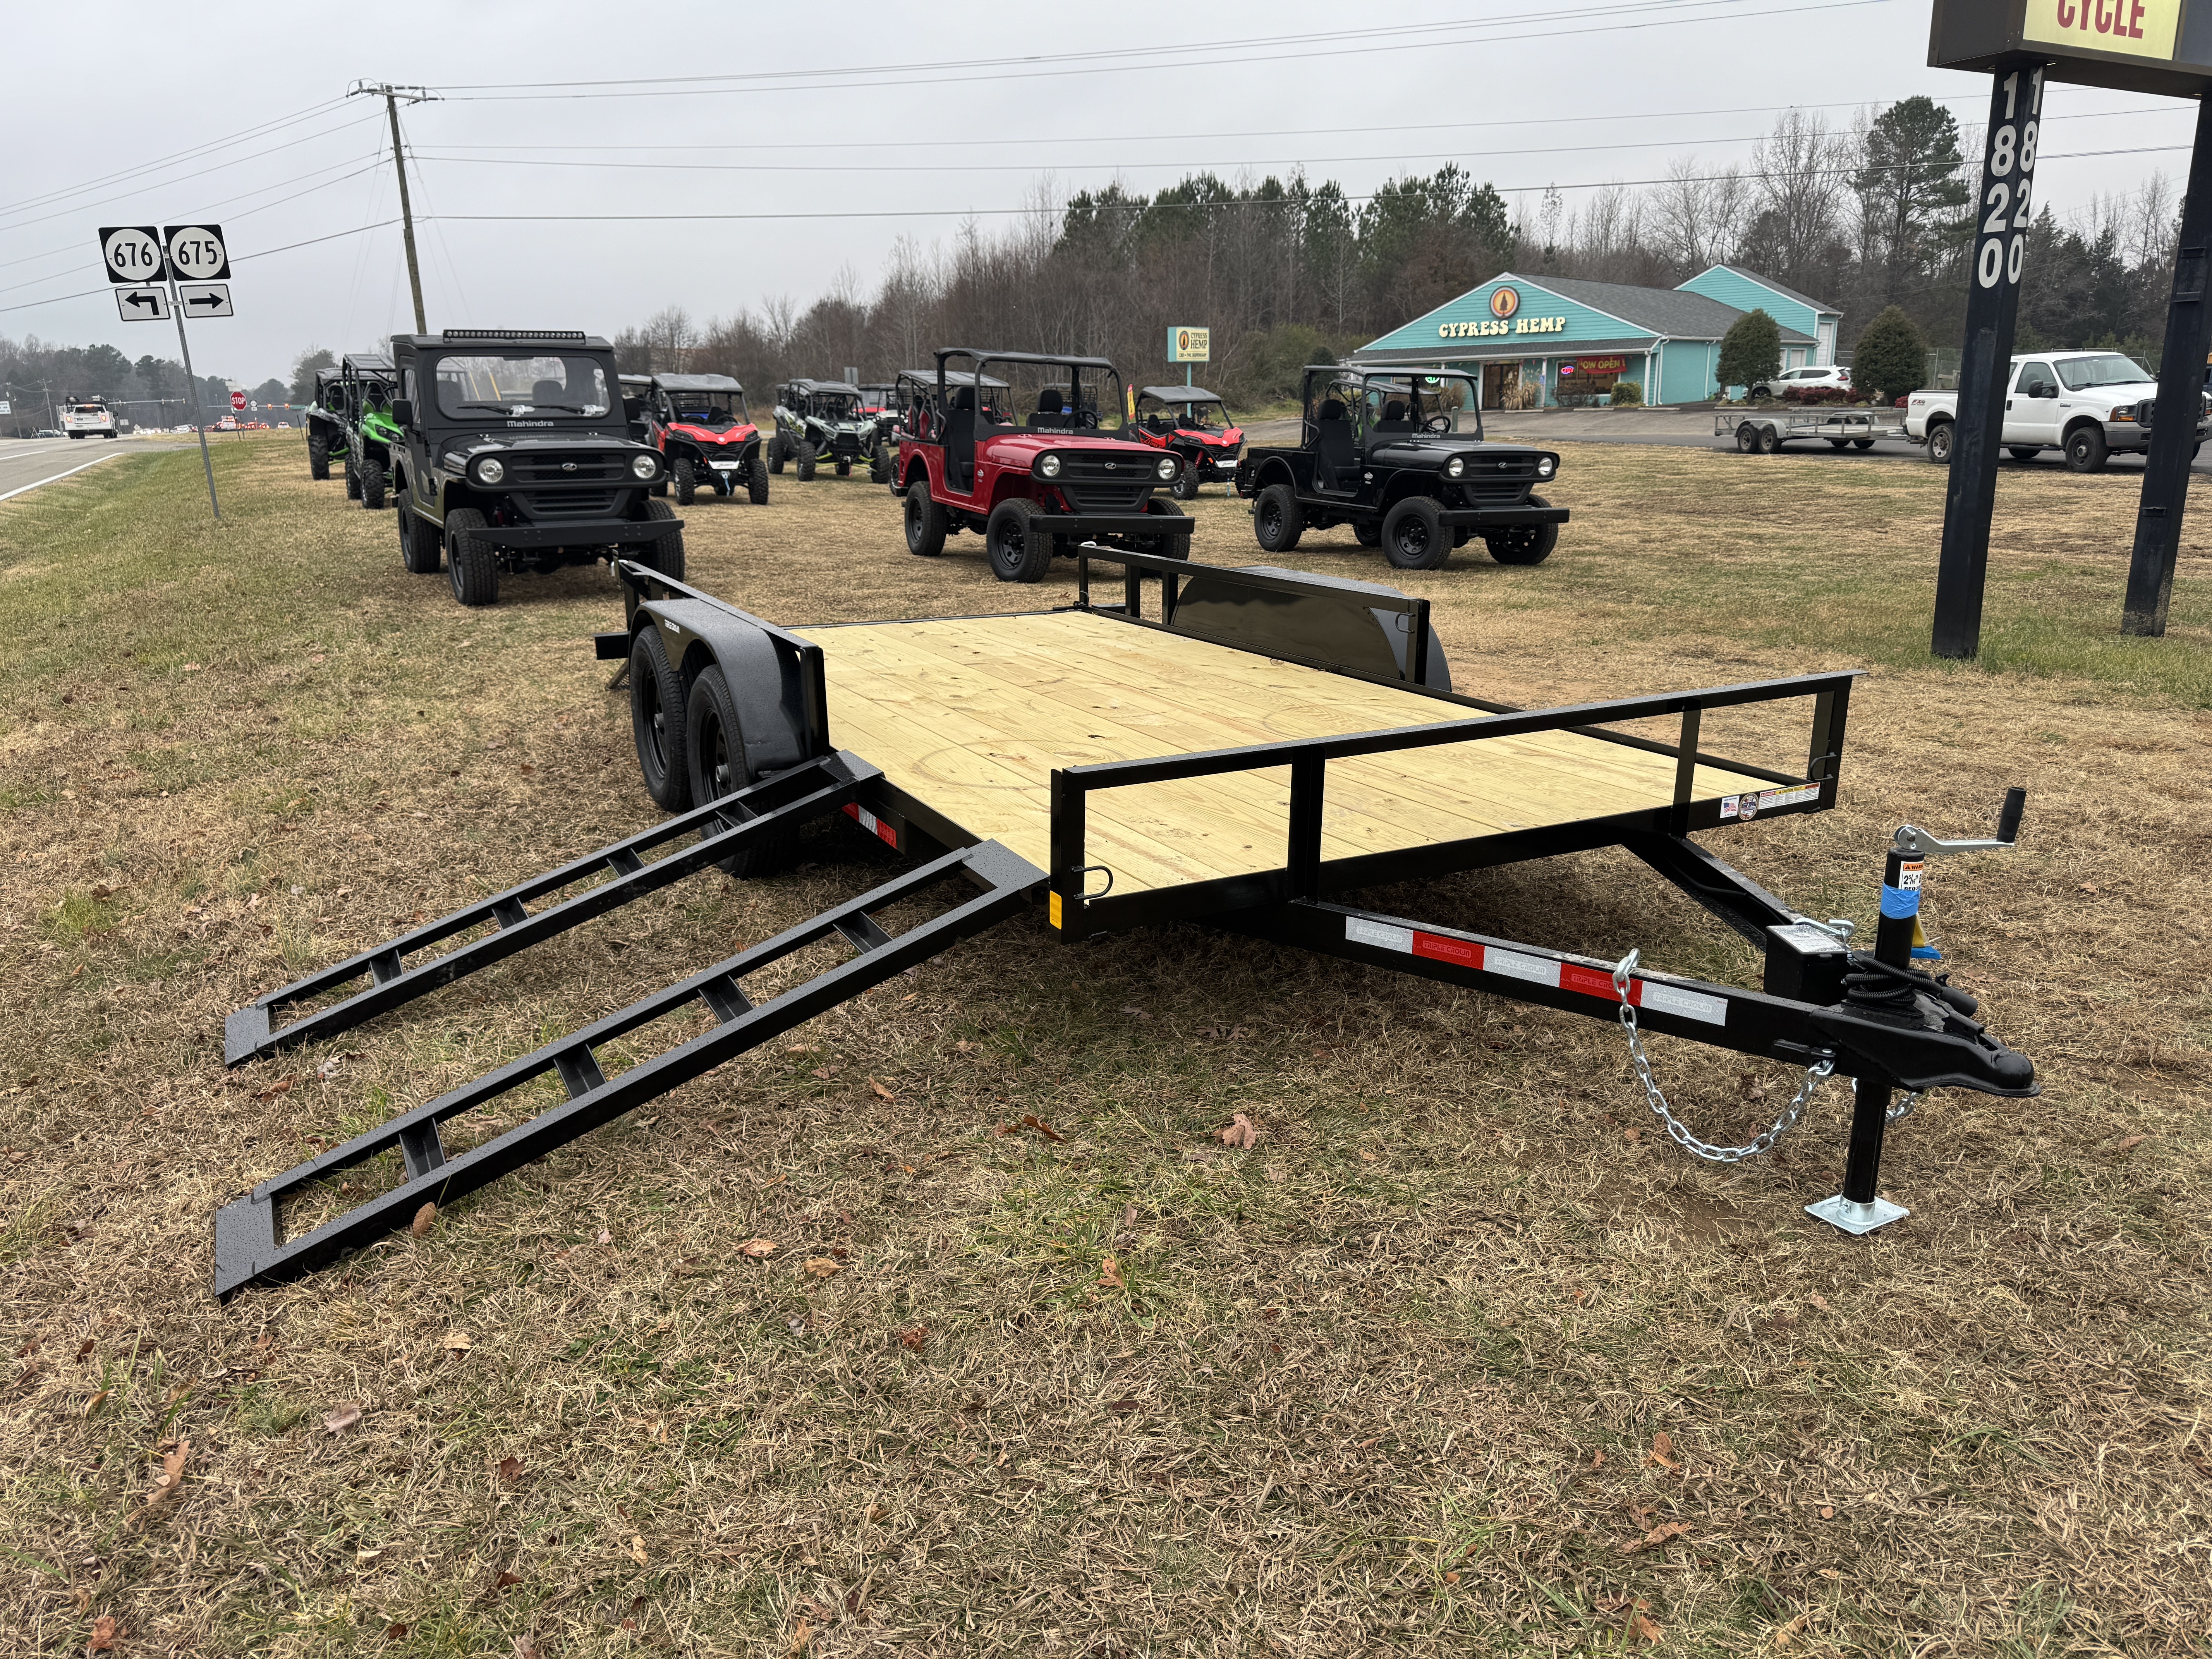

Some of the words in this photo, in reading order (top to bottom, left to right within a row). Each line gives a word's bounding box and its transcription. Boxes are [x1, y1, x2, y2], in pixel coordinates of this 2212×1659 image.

[2057, 0, 2145, 39] CYCLE
[114, 242, 153, 267] 676
[178, 240, 217, 265] 675
[1438, 320, 1509, 338] CYPRESS
[1515, 317, 1566, 334] HEMP
[1190, 339, 1207, 349] HEMP
[1598, 360, 1621, 369] OPEN
[231, 397, 245, 405] STOP
[1446, 947, 1470, 957] CROWN
[1599, 981, 1613, 989] CRO
